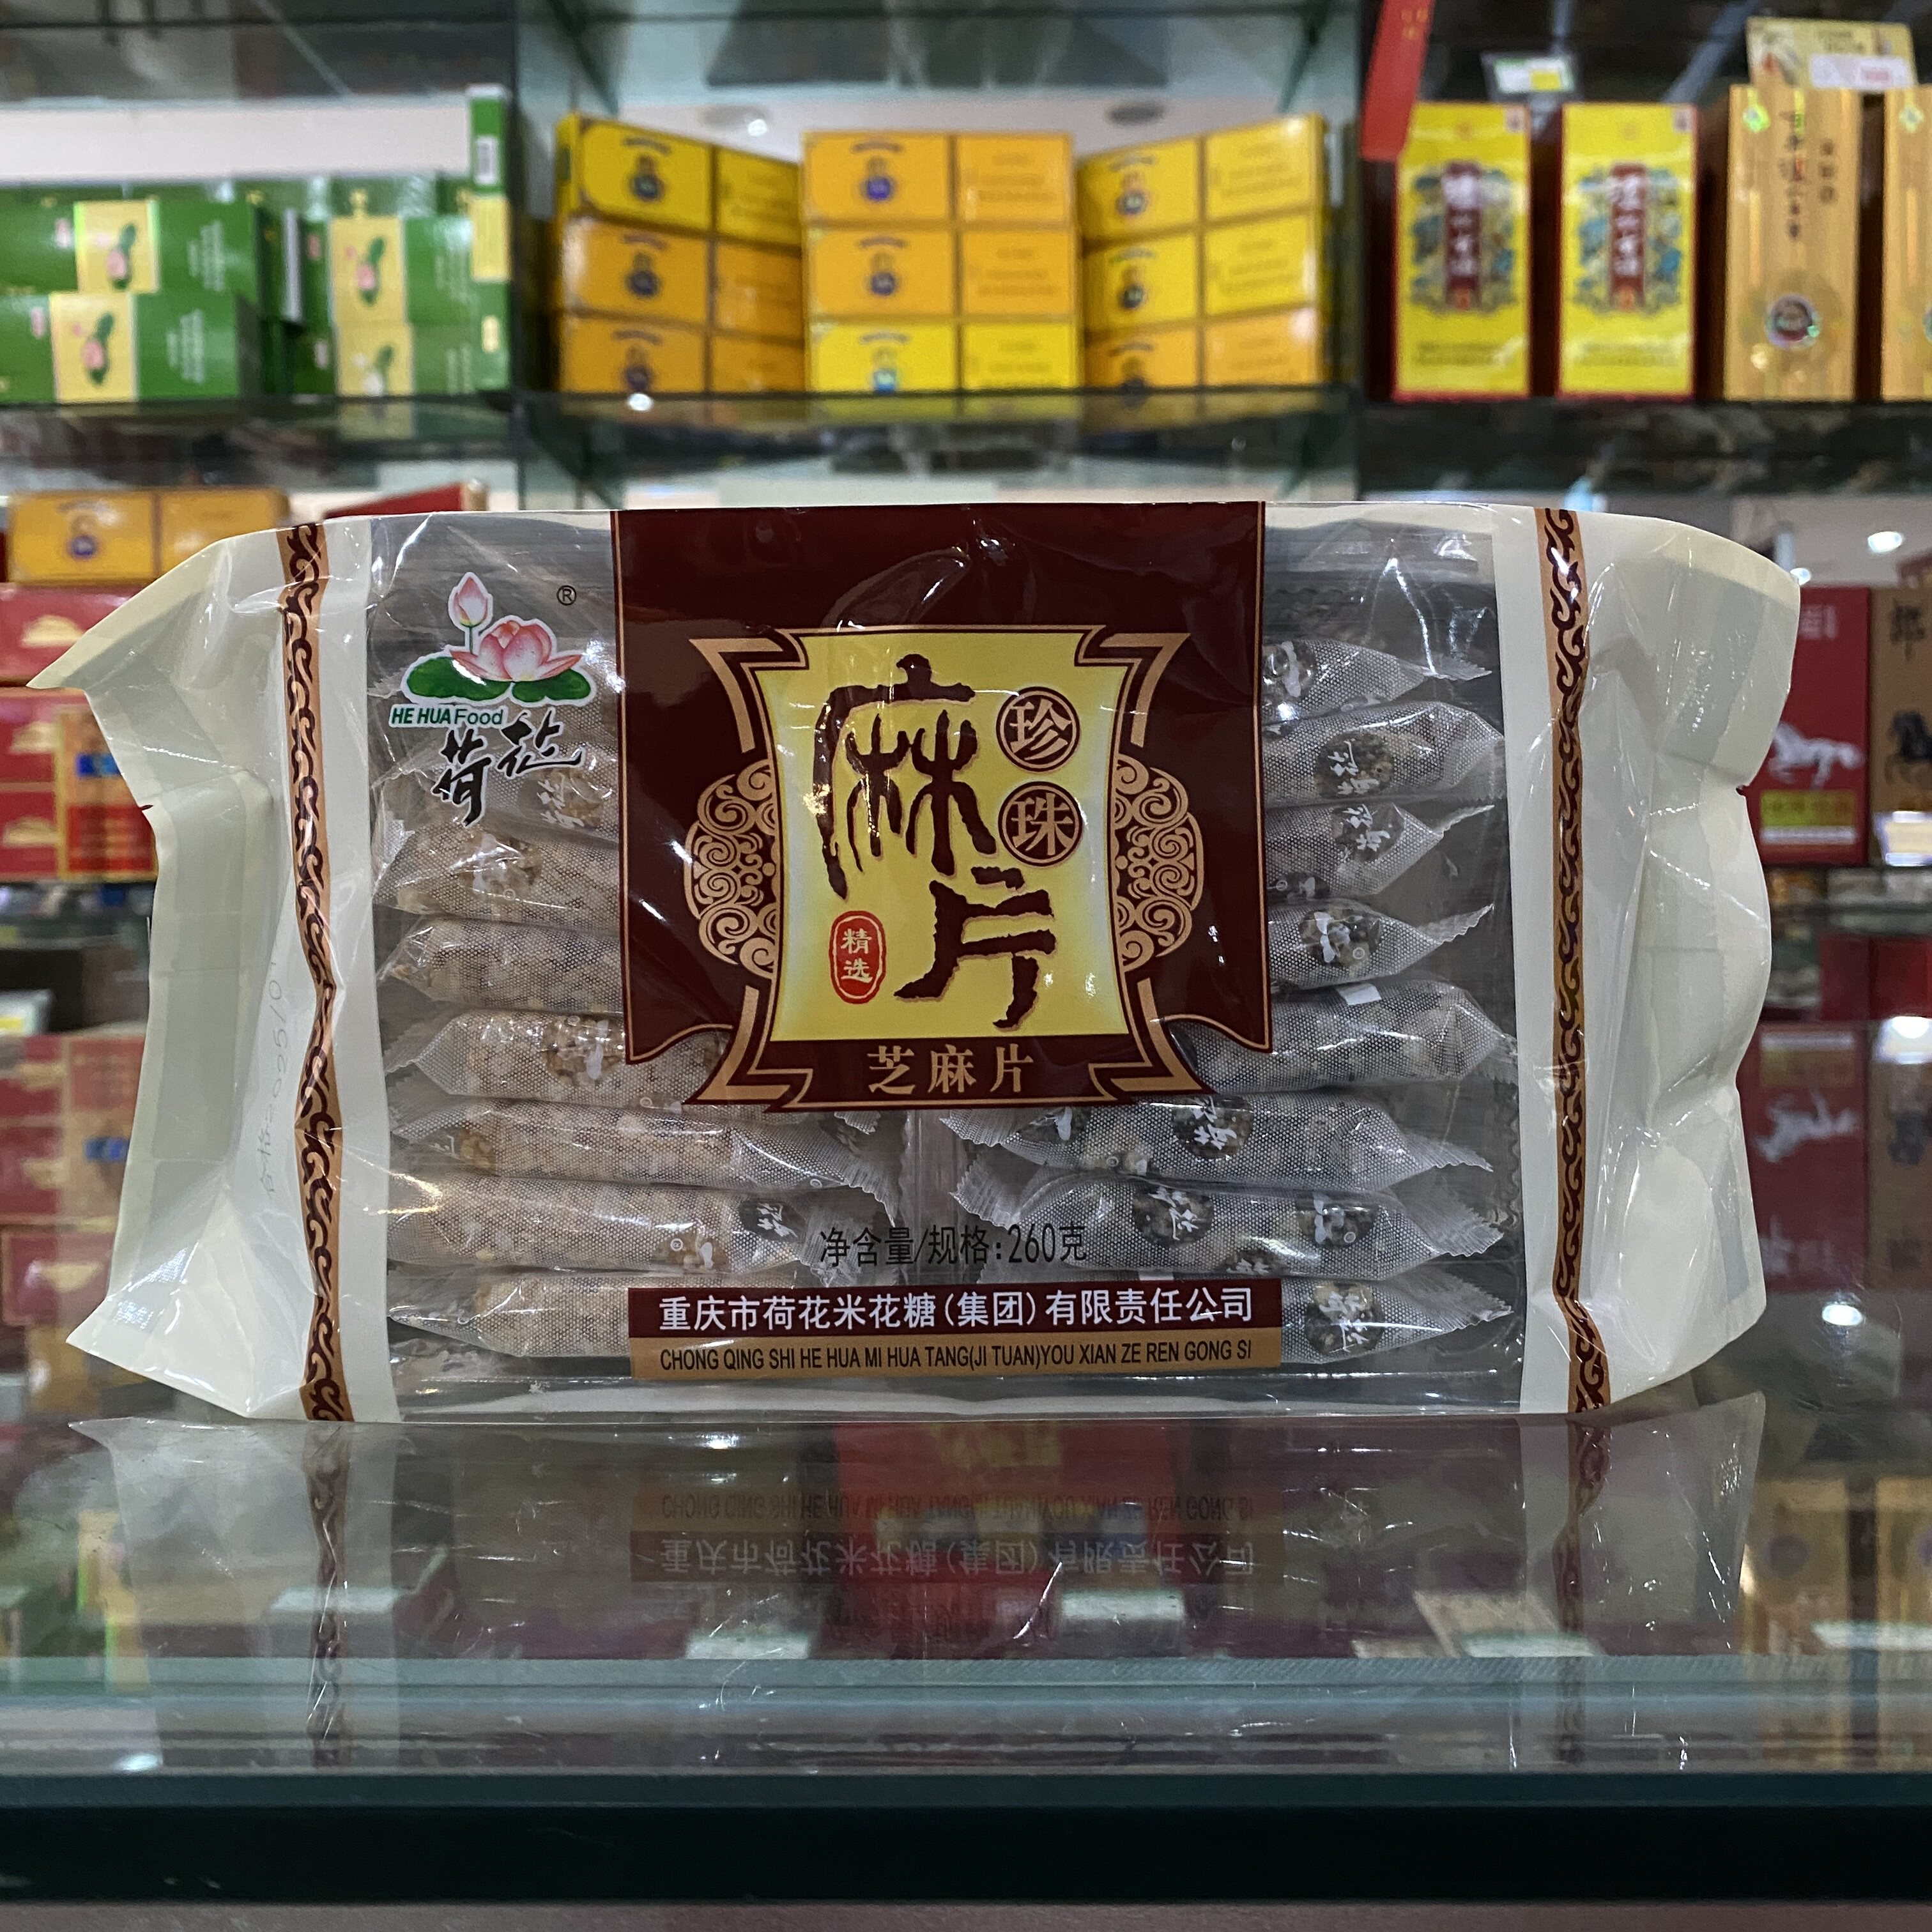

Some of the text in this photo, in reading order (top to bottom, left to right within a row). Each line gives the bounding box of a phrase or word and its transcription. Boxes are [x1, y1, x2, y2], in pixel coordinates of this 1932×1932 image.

[391, 708, 413, 724] HE
[1008, 696, 1076, 857] 珍珠
[811, 654, 1056, 1029] 麻片
[839, 928, 873, 983] 精选
[867, 1043, 1034, 1094] 芝麻片
[661, 1349, 719, 1370] CHONG
[724, 1348, 764, 1371] QING
[769, 1347, 795, 1369] SHI
[801, 1347, 822, 1368] HE
[827, 1347, 861, 1368] HUA
[865, 1346, 882, 1367] MI
[888, 1346, 921, 1367] HUA
[1079, 1342, 1117, 1365] XIAN
[1121, 1342, 1141, 1363] ZE
[1147, 1341, 1180, 1362] REN
[1184, 1339, 1232, 1361] GONG
[1237, 1339, 1252, 1360] SI
